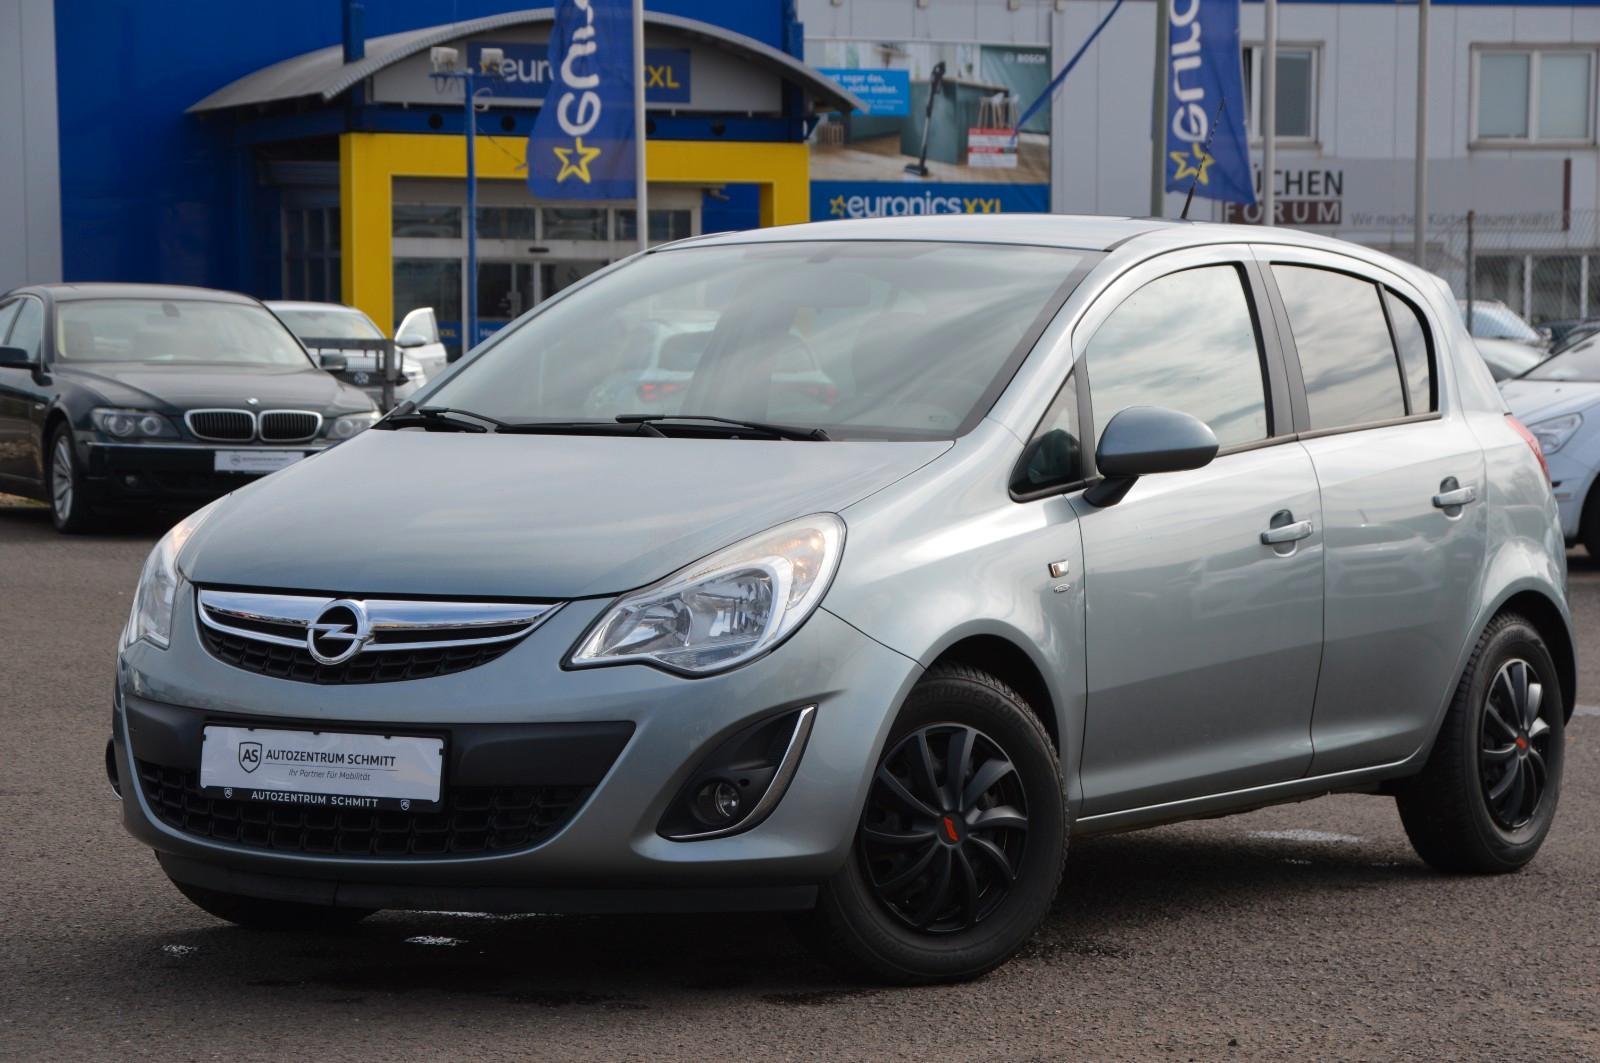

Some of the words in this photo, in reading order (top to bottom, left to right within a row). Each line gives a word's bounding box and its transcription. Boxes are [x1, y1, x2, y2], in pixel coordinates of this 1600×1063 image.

[1225, 202, 1340, 223] FORUM
[241, 748, 259, 763] AS
[265, 749, 345, 765] AUTOZENTRUM
[347, 753, 397, 767] SCHMITT
[288, 768, 299, 777] Ihr
[299, 769, 325, 779] Partner
[339, 771, 371, 781] Mobilität
[251, 790, 326, 805] AUTOZENTRUM
[331, 796, 379, 808] SCHMITT
